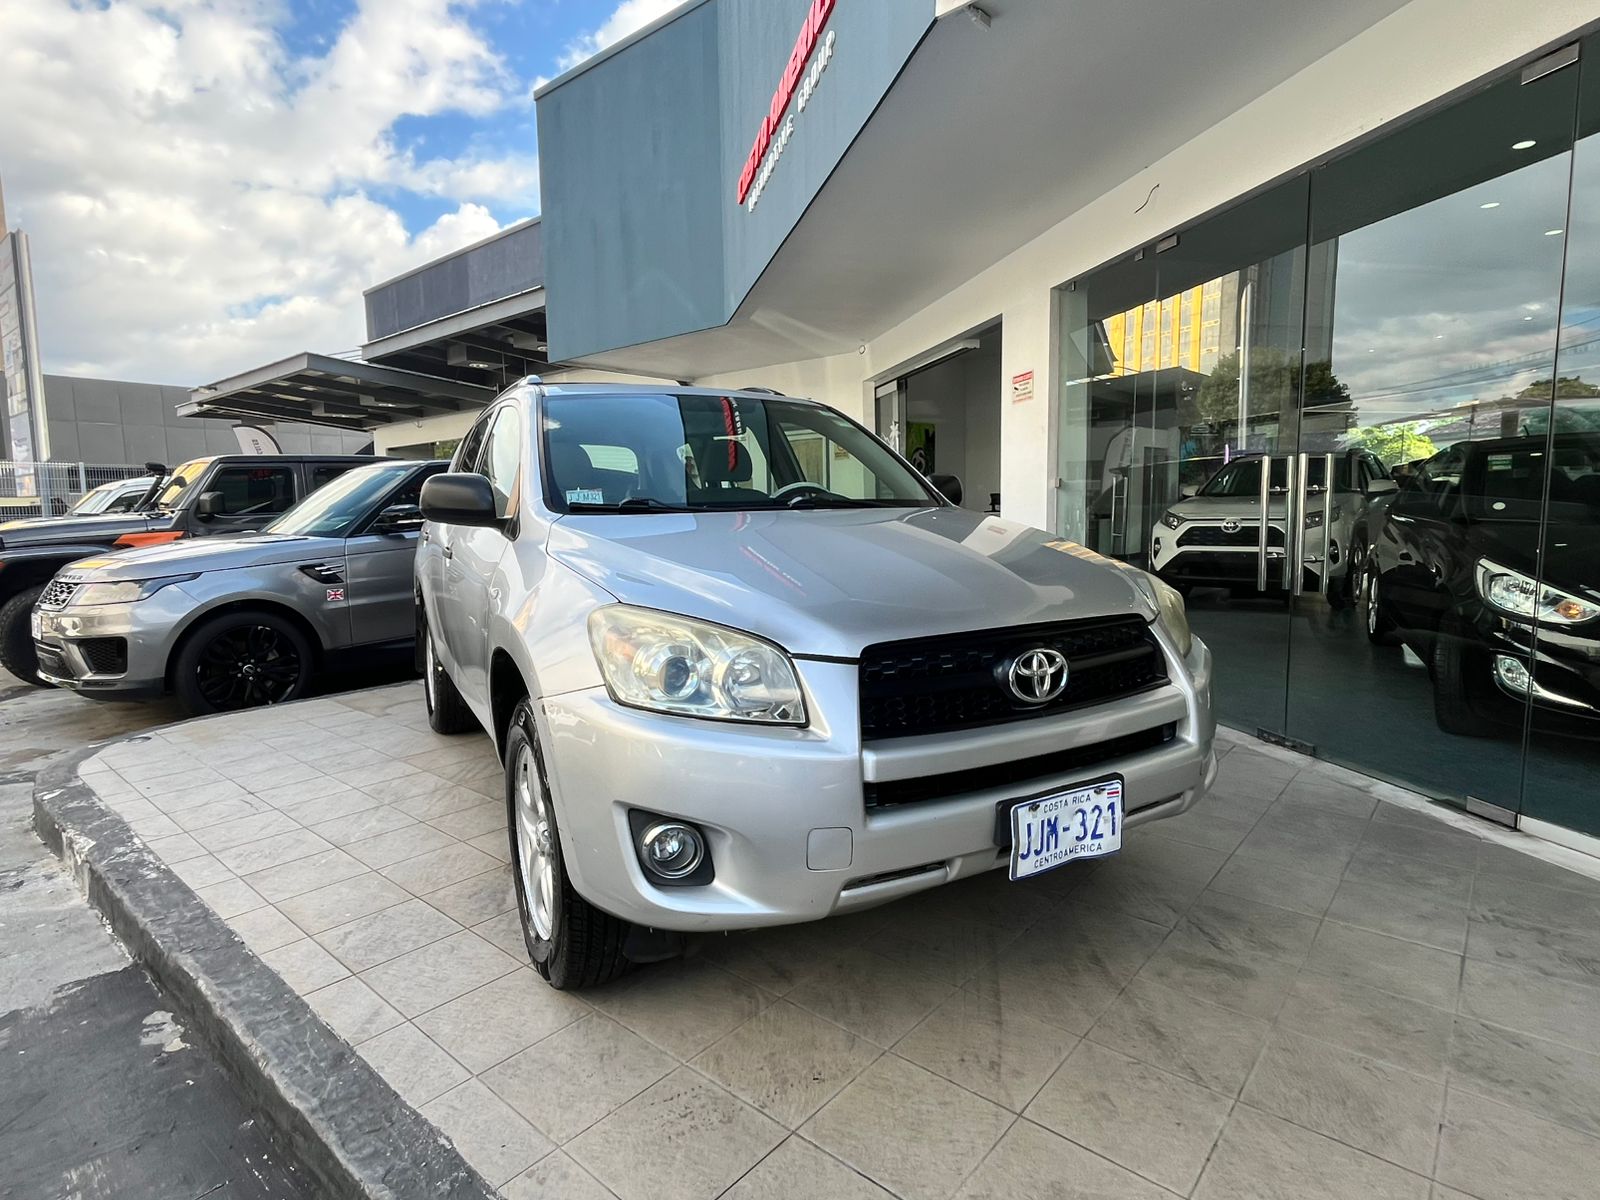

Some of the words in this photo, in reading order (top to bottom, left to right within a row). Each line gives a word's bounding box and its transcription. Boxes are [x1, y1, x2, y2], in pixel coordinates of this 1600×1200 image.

[798, 30, 836, 113] GROUP
[1043, 800, 1069, 814] COSTA
[1072, 793, 1092, 806] RICA
[1019, 801, 1117, 861] JJM-321
[1033, 842, 1103, 869] CENTROAMERICA
